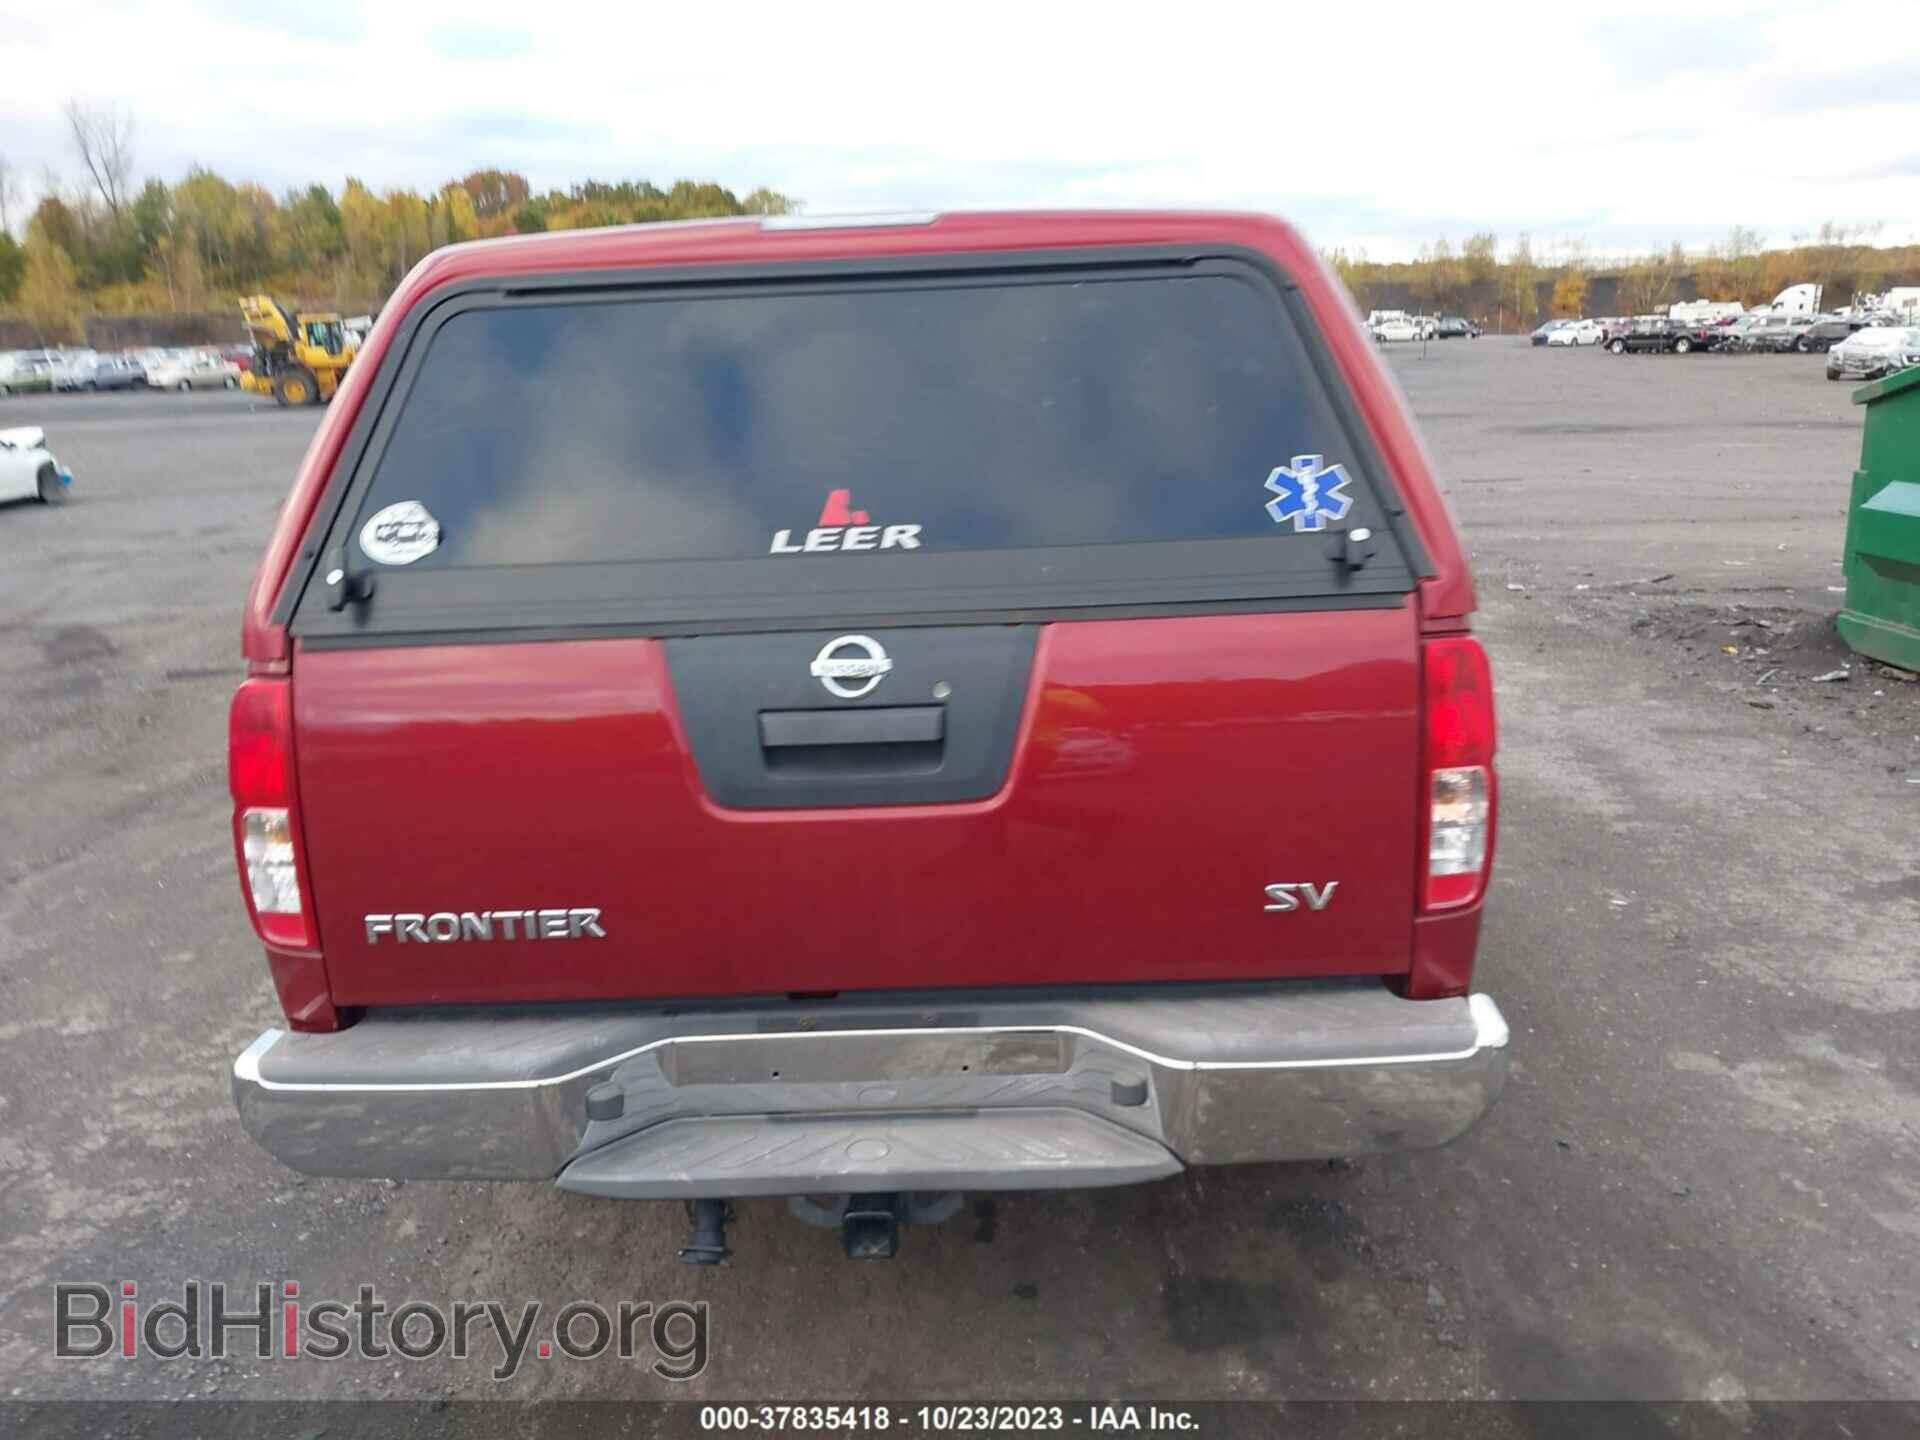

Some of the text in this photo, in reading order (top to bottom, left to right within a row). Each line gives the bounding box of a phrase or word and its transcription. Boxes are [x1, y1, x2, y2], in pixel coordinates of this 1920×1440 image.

[769, 524, 923, 554] LEER
[1263, 881, 1340, 912] SV
[364, 908, 607, 945] FRONTIER
